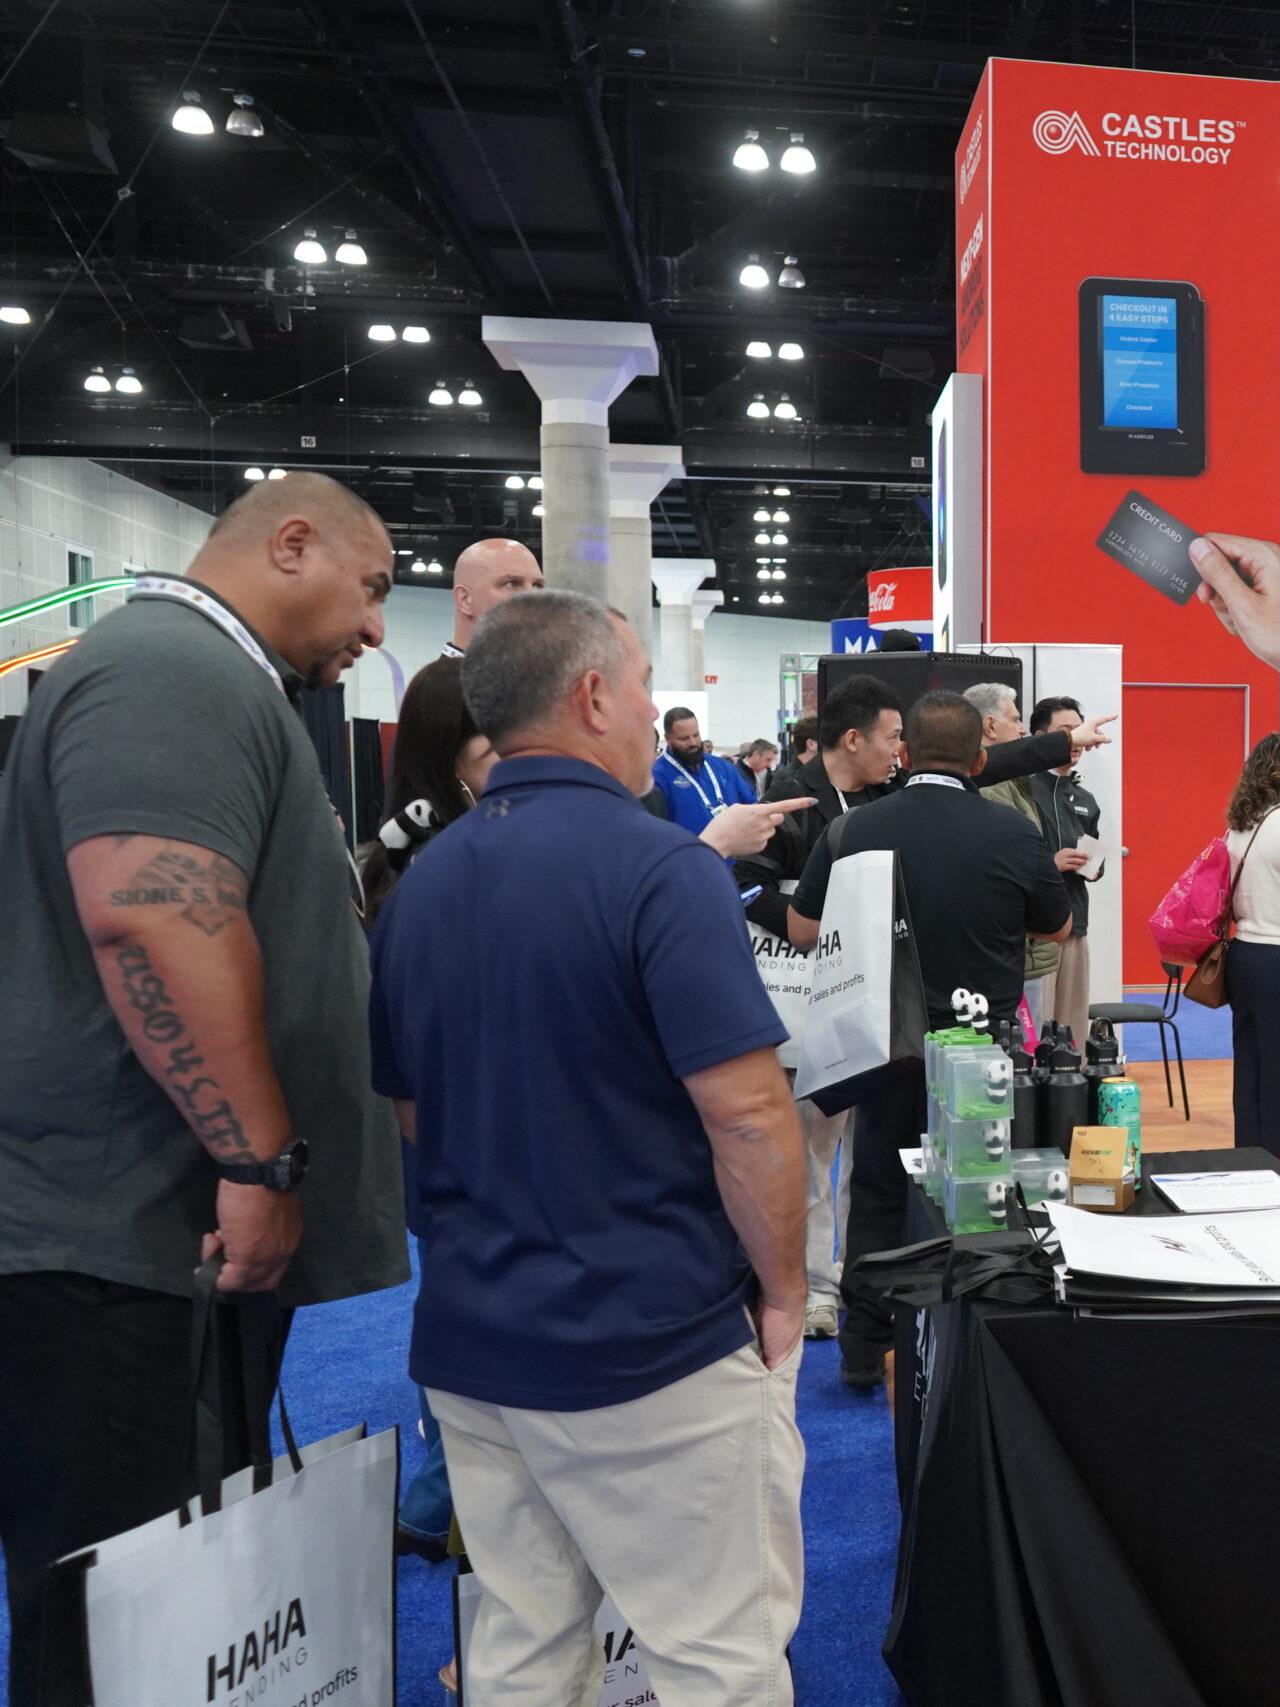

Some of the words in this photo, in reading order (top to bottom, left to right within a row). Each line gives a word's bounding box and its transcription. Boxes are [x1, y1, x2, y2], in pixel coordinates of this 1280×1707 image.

[1102, 112, 1235, 144] CASTLES
[1103, 140, 1231, 165] TECHNOLOGY
[1110, 303, 1157, 313] CHECKOUT
[1158, 305, 1168, 313] IN
[1116, 314, 1140, 322] EASY
[1140, 315, 1169, 324] STEPS
[1129, 502, 1160, 526] CREDIT
[1158, 523, 1183, 543] CARD
[757, 960, 807, 972] NDING
[782, 982, 802, 994] and
[813, 989, 829, 1003] sales
[830, 983, 842, 996] and
[842, 973, 865, 990] profits
[207, 1597, 307, 1703] HAHA
[311, 1666, 358, 1706] profits
